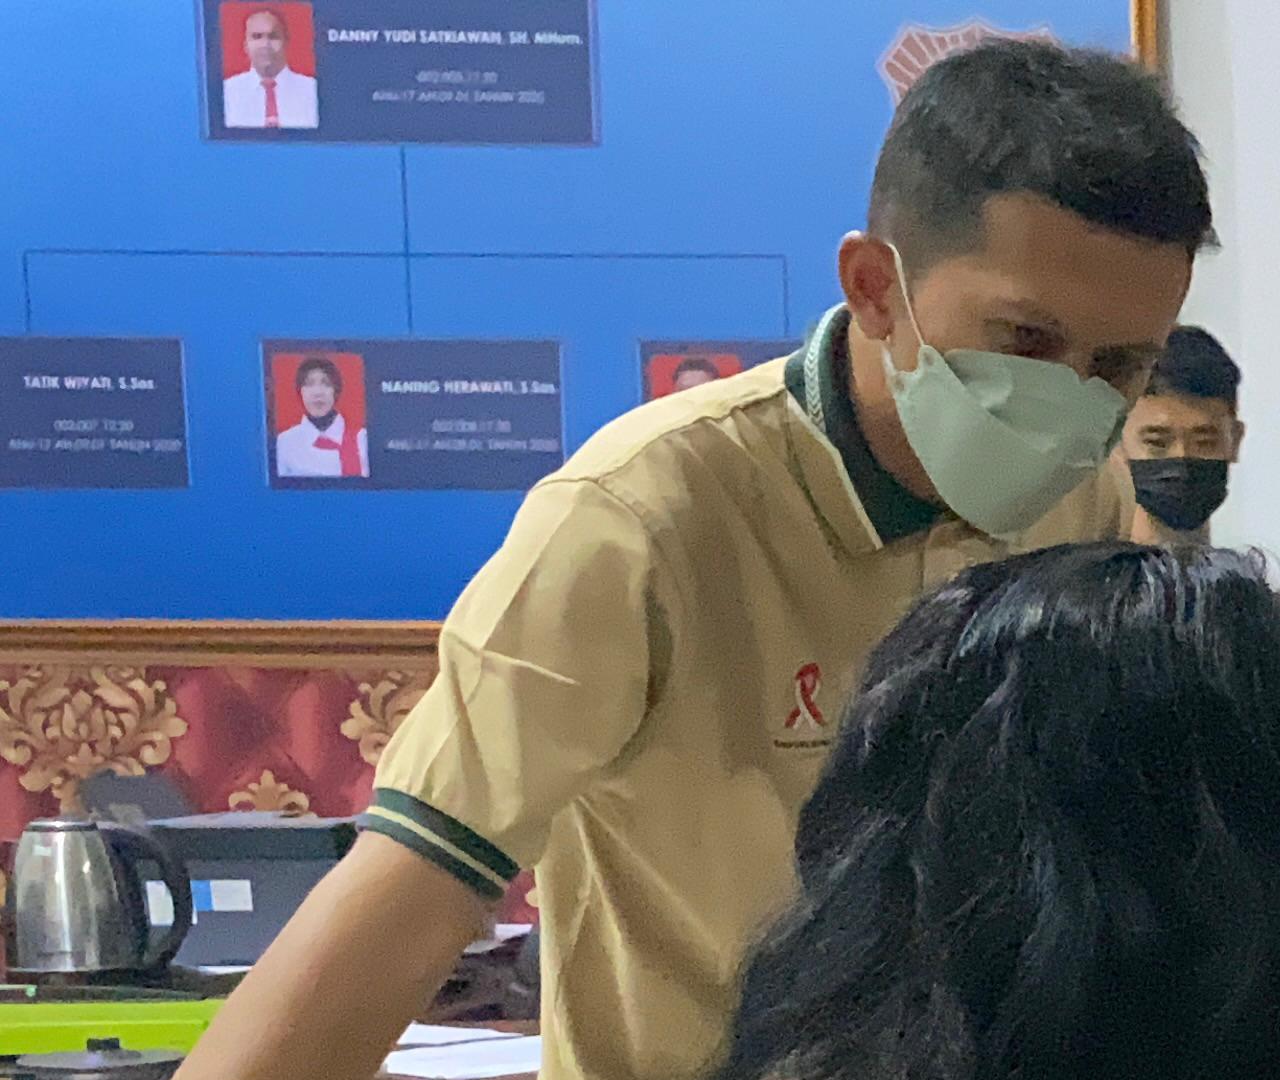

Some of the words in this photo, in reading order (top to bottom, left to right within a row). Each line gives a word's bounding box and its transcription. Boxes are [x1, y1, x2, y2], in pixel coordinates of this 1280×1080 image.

[328, 29, 379, 43] DANNY
[384, 29, 416, 43] YUDI
[381, 380, 440, 393] NANING
